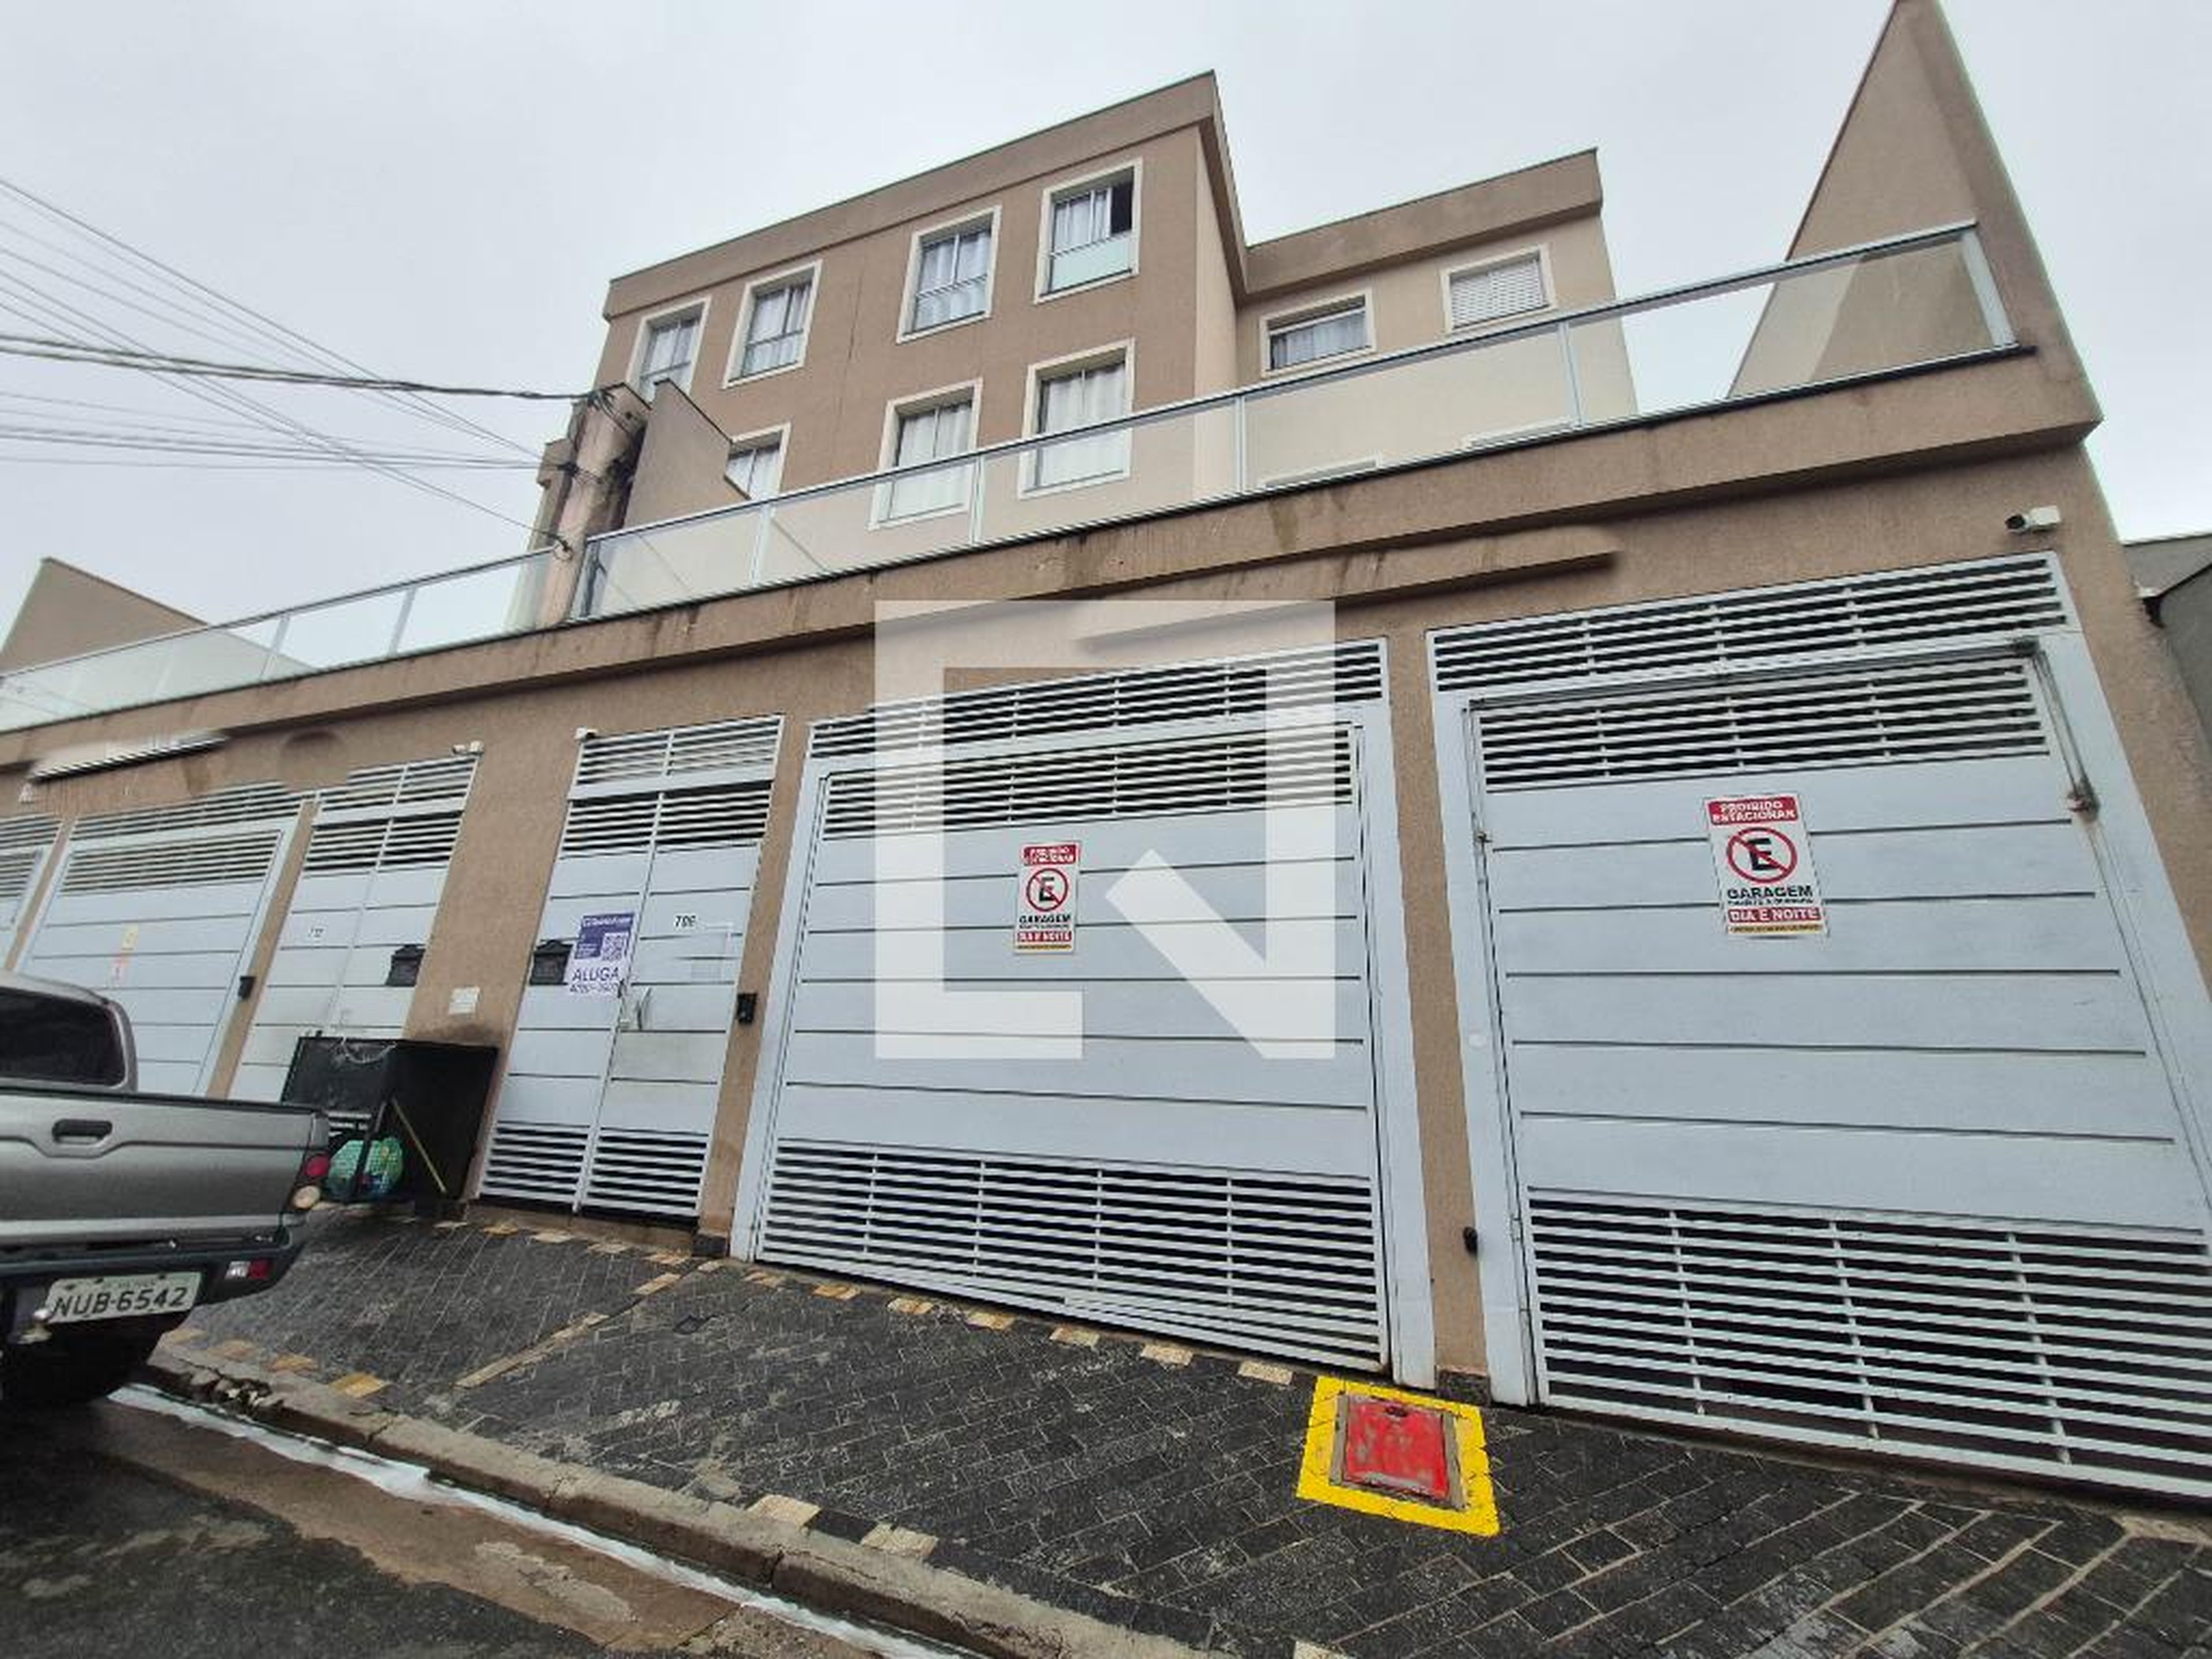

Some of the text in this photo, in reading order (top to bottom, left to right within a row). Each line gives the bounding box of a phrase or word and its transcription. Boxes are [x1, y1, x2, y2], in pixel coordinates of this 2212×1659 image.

[1727, 885, 1813, 899] GARAGEM
[1729, 908, 1819, 921] DIA E NOITE
[572, 967, 619, 981] ALUGA
